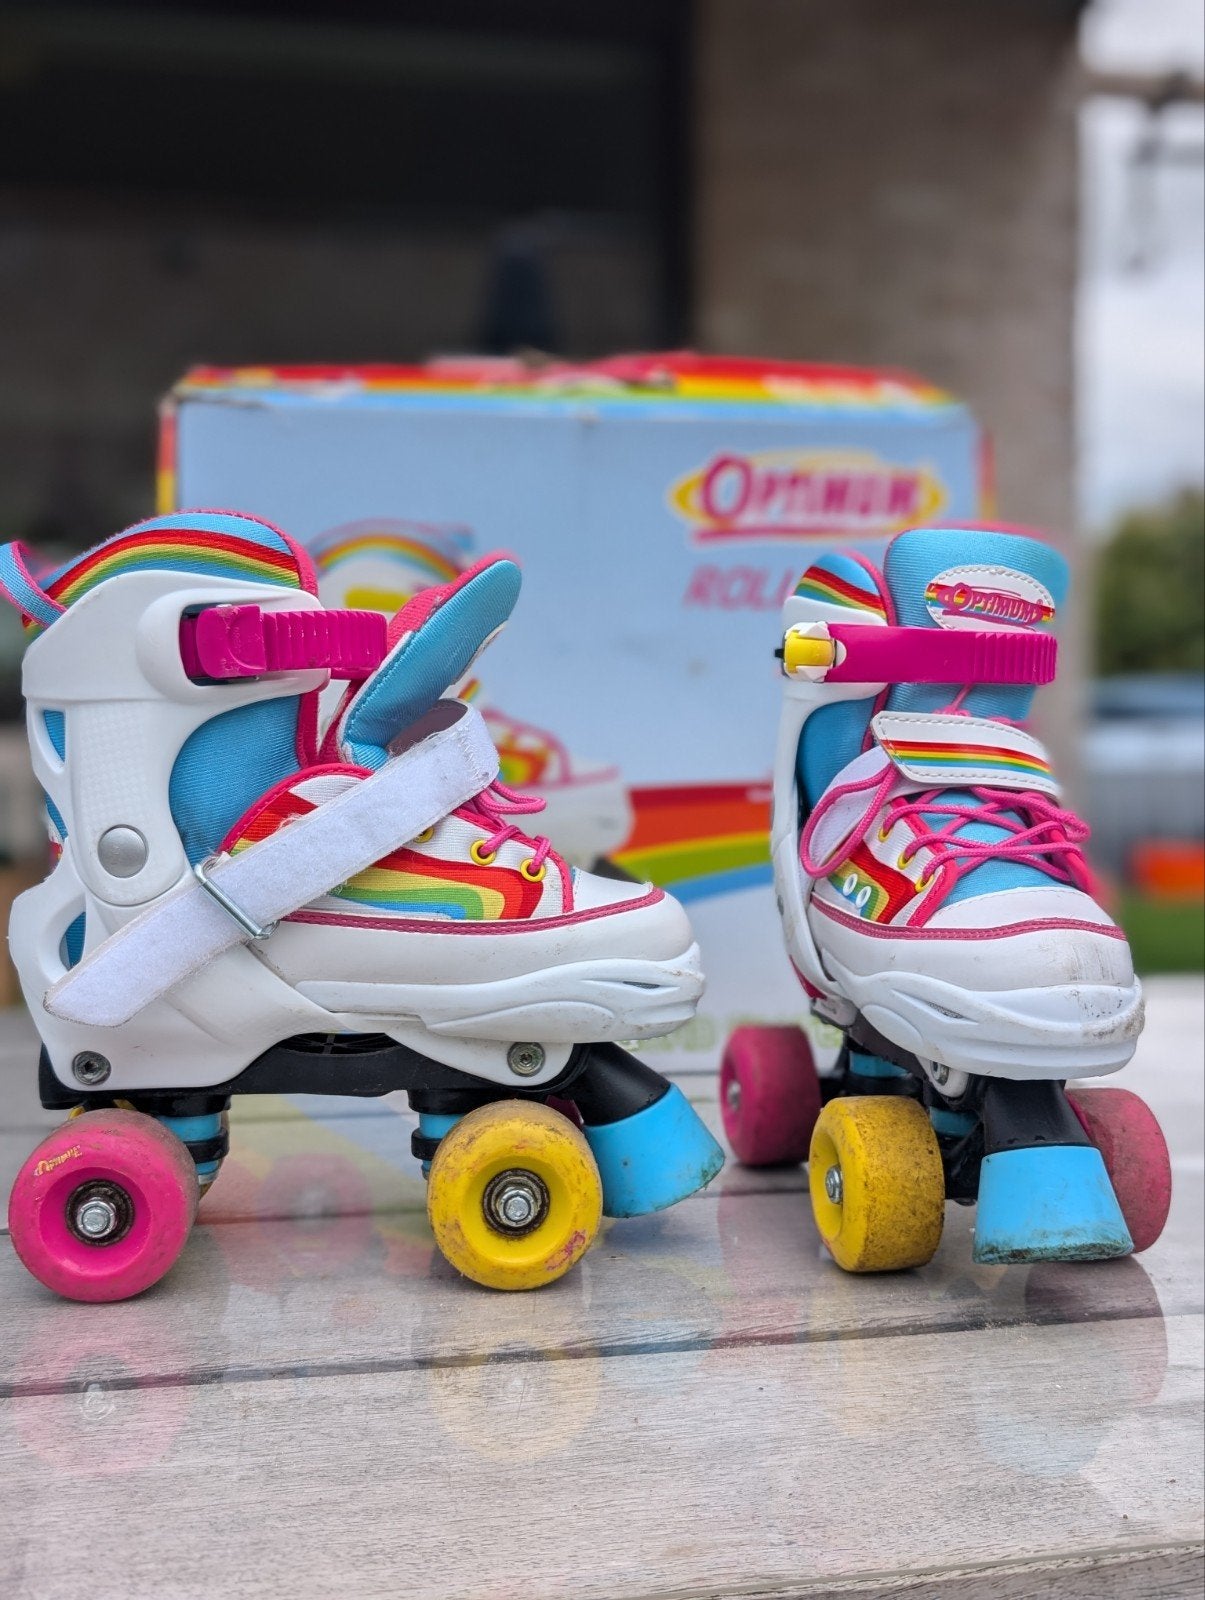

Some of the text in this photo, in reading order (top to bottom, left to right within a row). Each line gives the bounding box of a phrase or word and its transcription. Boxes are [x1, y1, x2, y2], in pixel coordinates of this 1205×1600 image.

[702, 453, 921, 525] OPTIMUM
[683, 564, 795, 611] ROLL
[952, 585, 1035, 624] OPTIMUM
